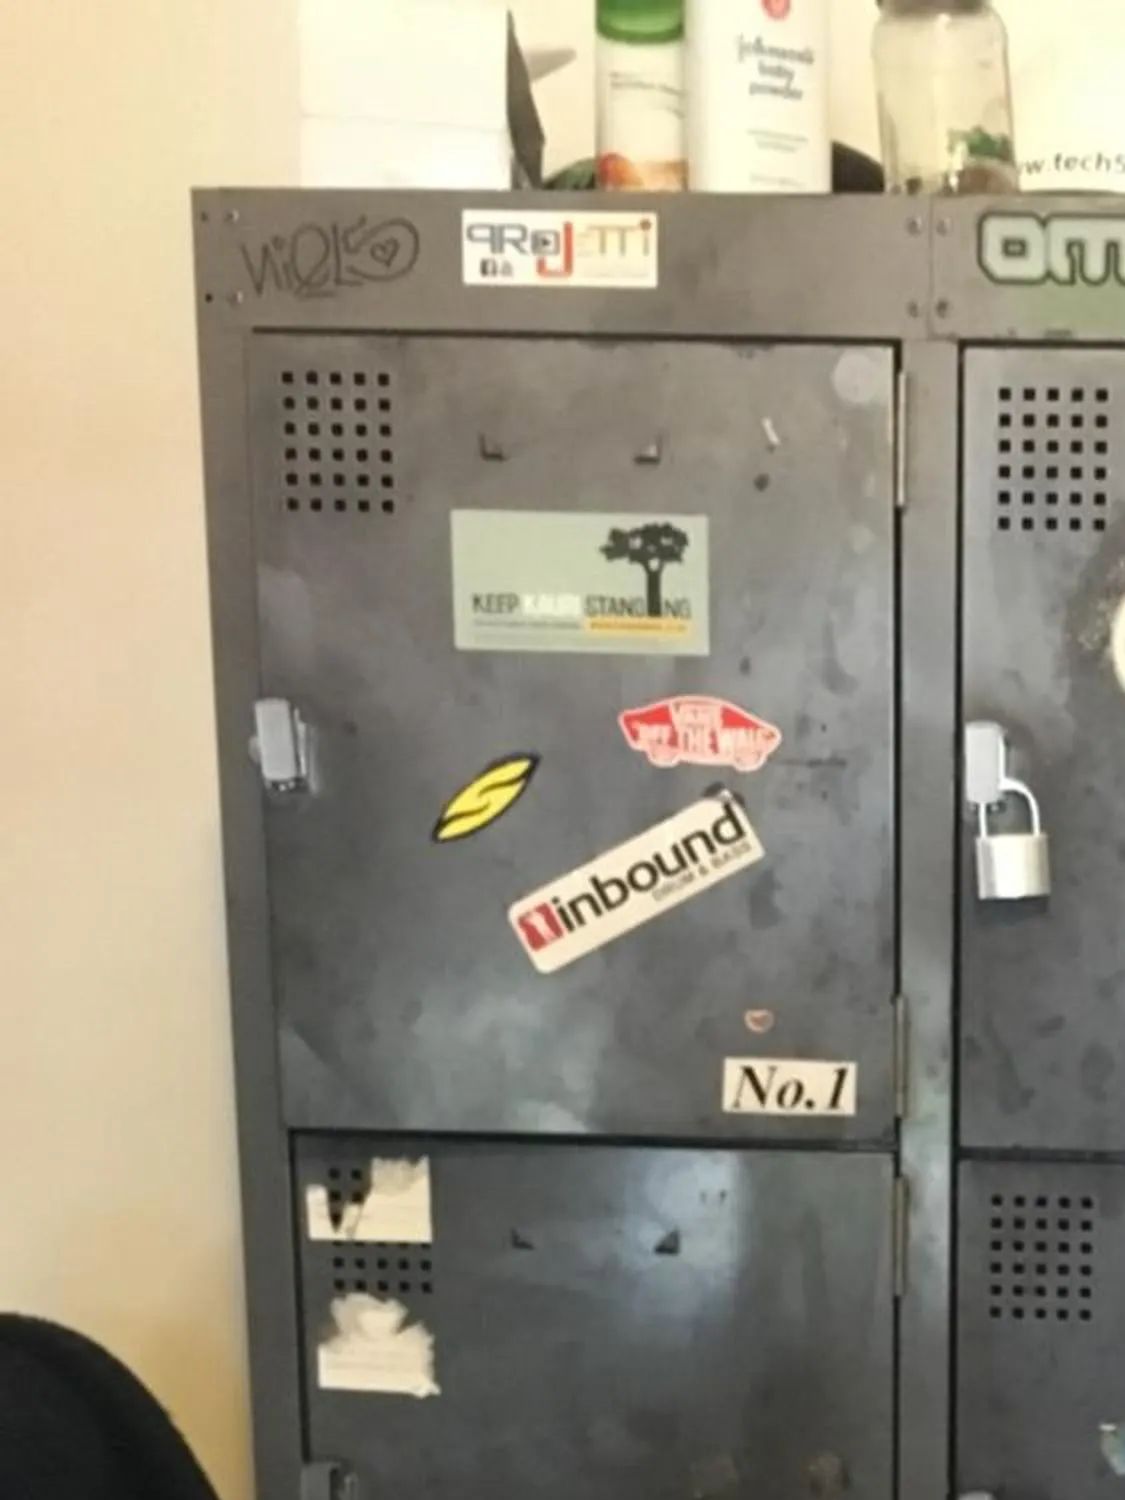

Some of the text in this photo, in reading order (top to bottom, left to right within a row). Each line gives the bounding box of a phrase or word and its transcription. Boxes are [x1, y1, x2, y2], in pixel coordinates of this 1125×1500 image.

[472, 593, 519, 615] KEEP
[550, 798, 747, 934] inbound
[731, 1064, 849, 1111] No.1
